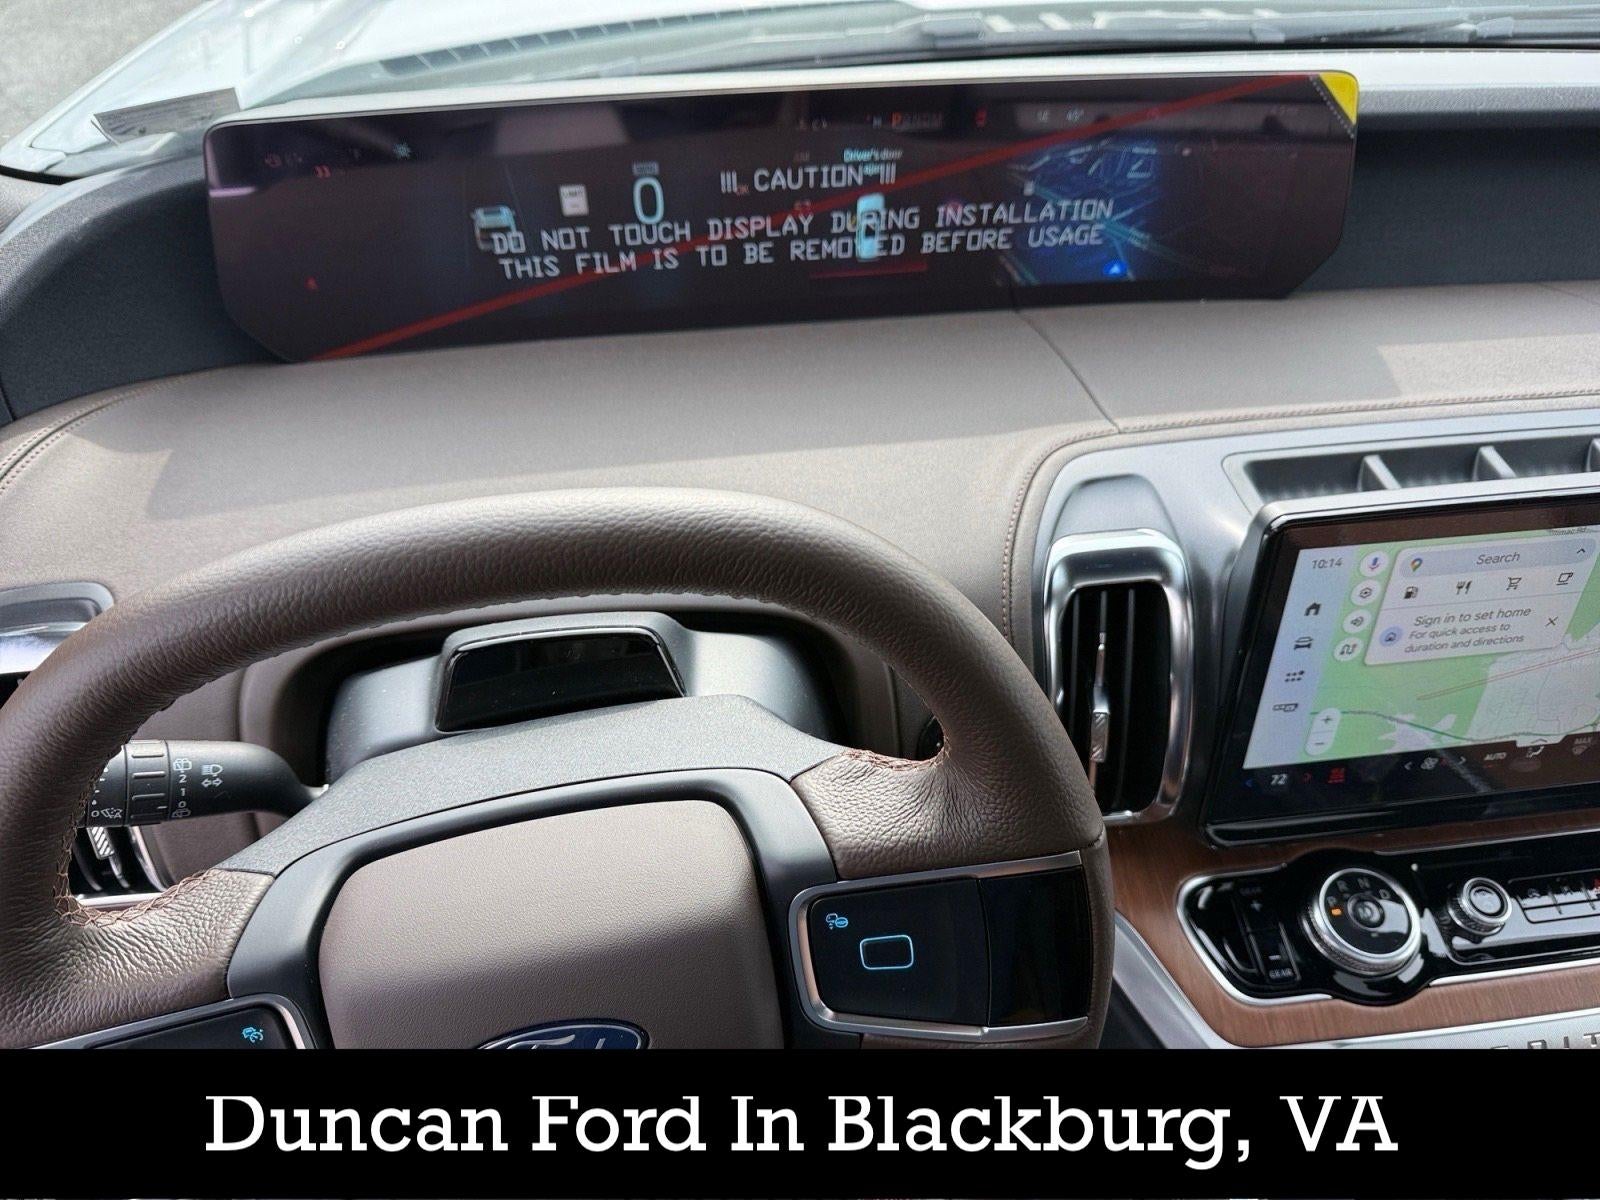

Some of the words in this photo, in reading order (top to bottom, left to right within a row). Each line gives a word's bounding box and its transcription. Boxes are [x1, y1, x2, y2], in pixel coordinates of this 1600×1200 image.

[753, 164, 863, 192] CAUTION
[633, 176, 664, 224] 0
[490, 231, 526, 255] DO
[541, 226, 590, 250] NOT
[608, 219, 691, 246] TOUCH
[706, 214, 814, 241] DISPLAY
[830, 206, 920, 234] DURING
[935, 198, 1114, 228] INSTALLATION
[499, 255, 560, 280] THIS
[575, 250, 637, 275] FILM
[652, 247, 679, 270] IS
[695, 244, 727, 267] TO
[743, 241, 774, 265] BE
[920, 227, 1014, 254] BEFORE
[1028, 223, 1105, 248] USAGE
[1312, 558, 1343, 569] 10:14
[1476, 552, 1520, 565] Search
[1414, 615, 1440, 627] Sign
[1443, 613, 1455, 623] in
[1459, 613, 1471, 622] to
[1475, 611, 1493, 620] set
[1496, 607, 1531, 618] home
[1409, 630, 1427, 639] For
[1429, 628, 1457, 639] quick
[1460, 625, 1497, 635] access
[1499, 623, 1510, 631] to
[1404, 642, 1449, 653] duration
[1450, 639, 1472, 648] and
[1473, 635, 1525, 647] directions
[179, 774, 187, 783] 2
[180, 788, 186, 796] 1
